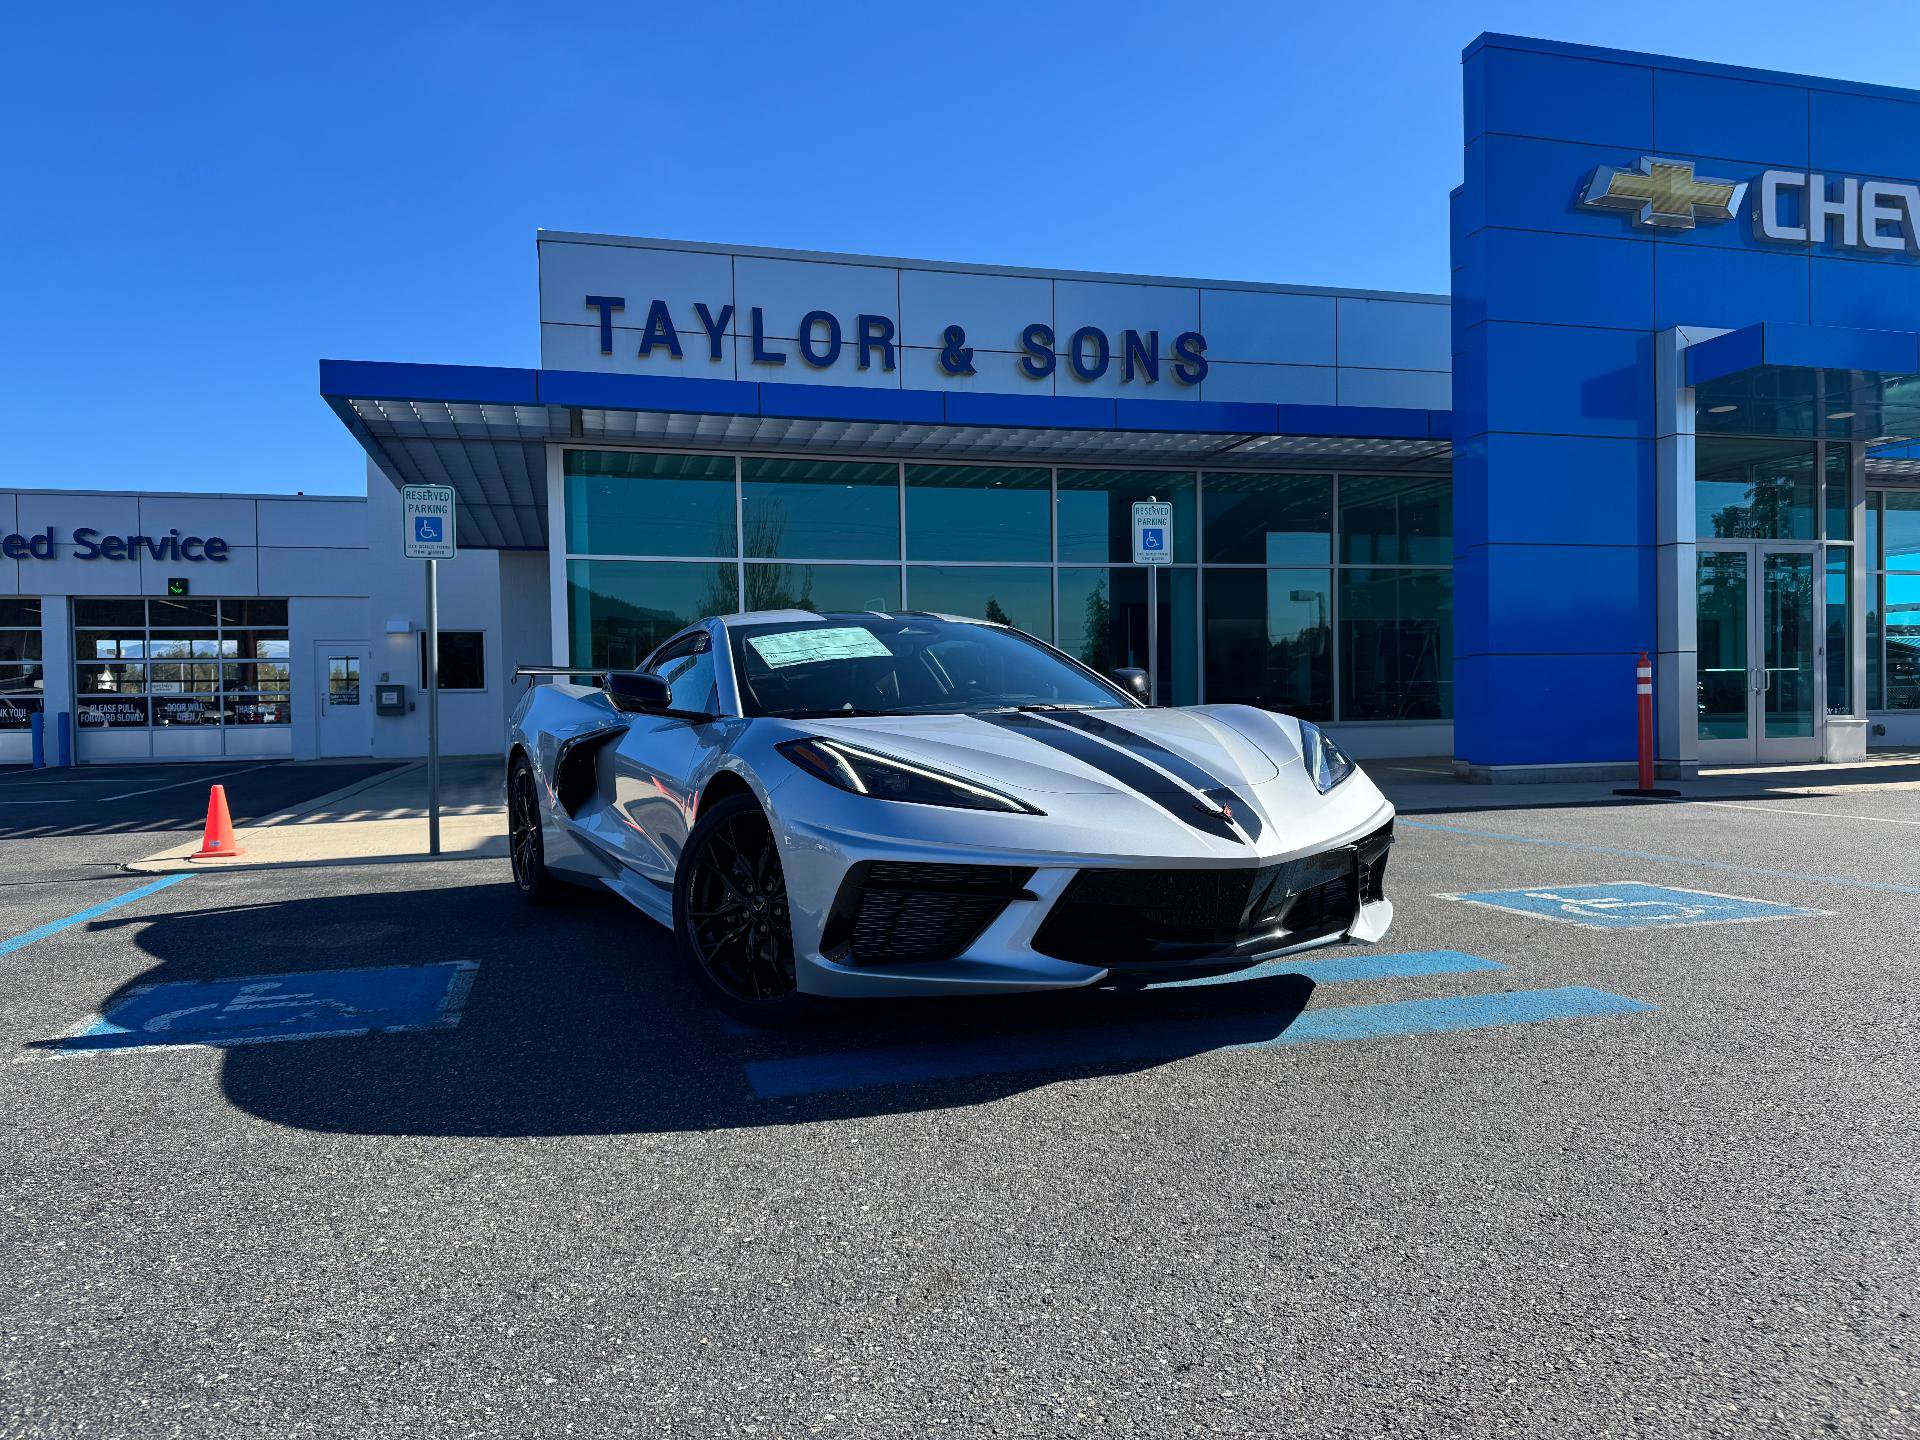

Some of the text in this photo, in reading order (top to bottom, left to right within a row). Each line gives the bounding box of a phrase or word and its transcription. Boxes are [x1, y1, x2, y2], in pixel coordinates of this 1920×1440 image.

[585, 295, 1209, 385] TAYLOR & SONS
[406, 491, 449, 502] RESERVED
[408, 504, 447, 514] PARKING
[1135, 507, 1169, 516] RESERVED
[1137, 517, 1167, 526] PARKING
[72, 527, 229, 562] Service
[90, 703, 136, 713] PLEASE PULL
[167, 703, 205, 712] DOOR WILL
[80, 712, 145, 723] FORWARD SLOWLY
